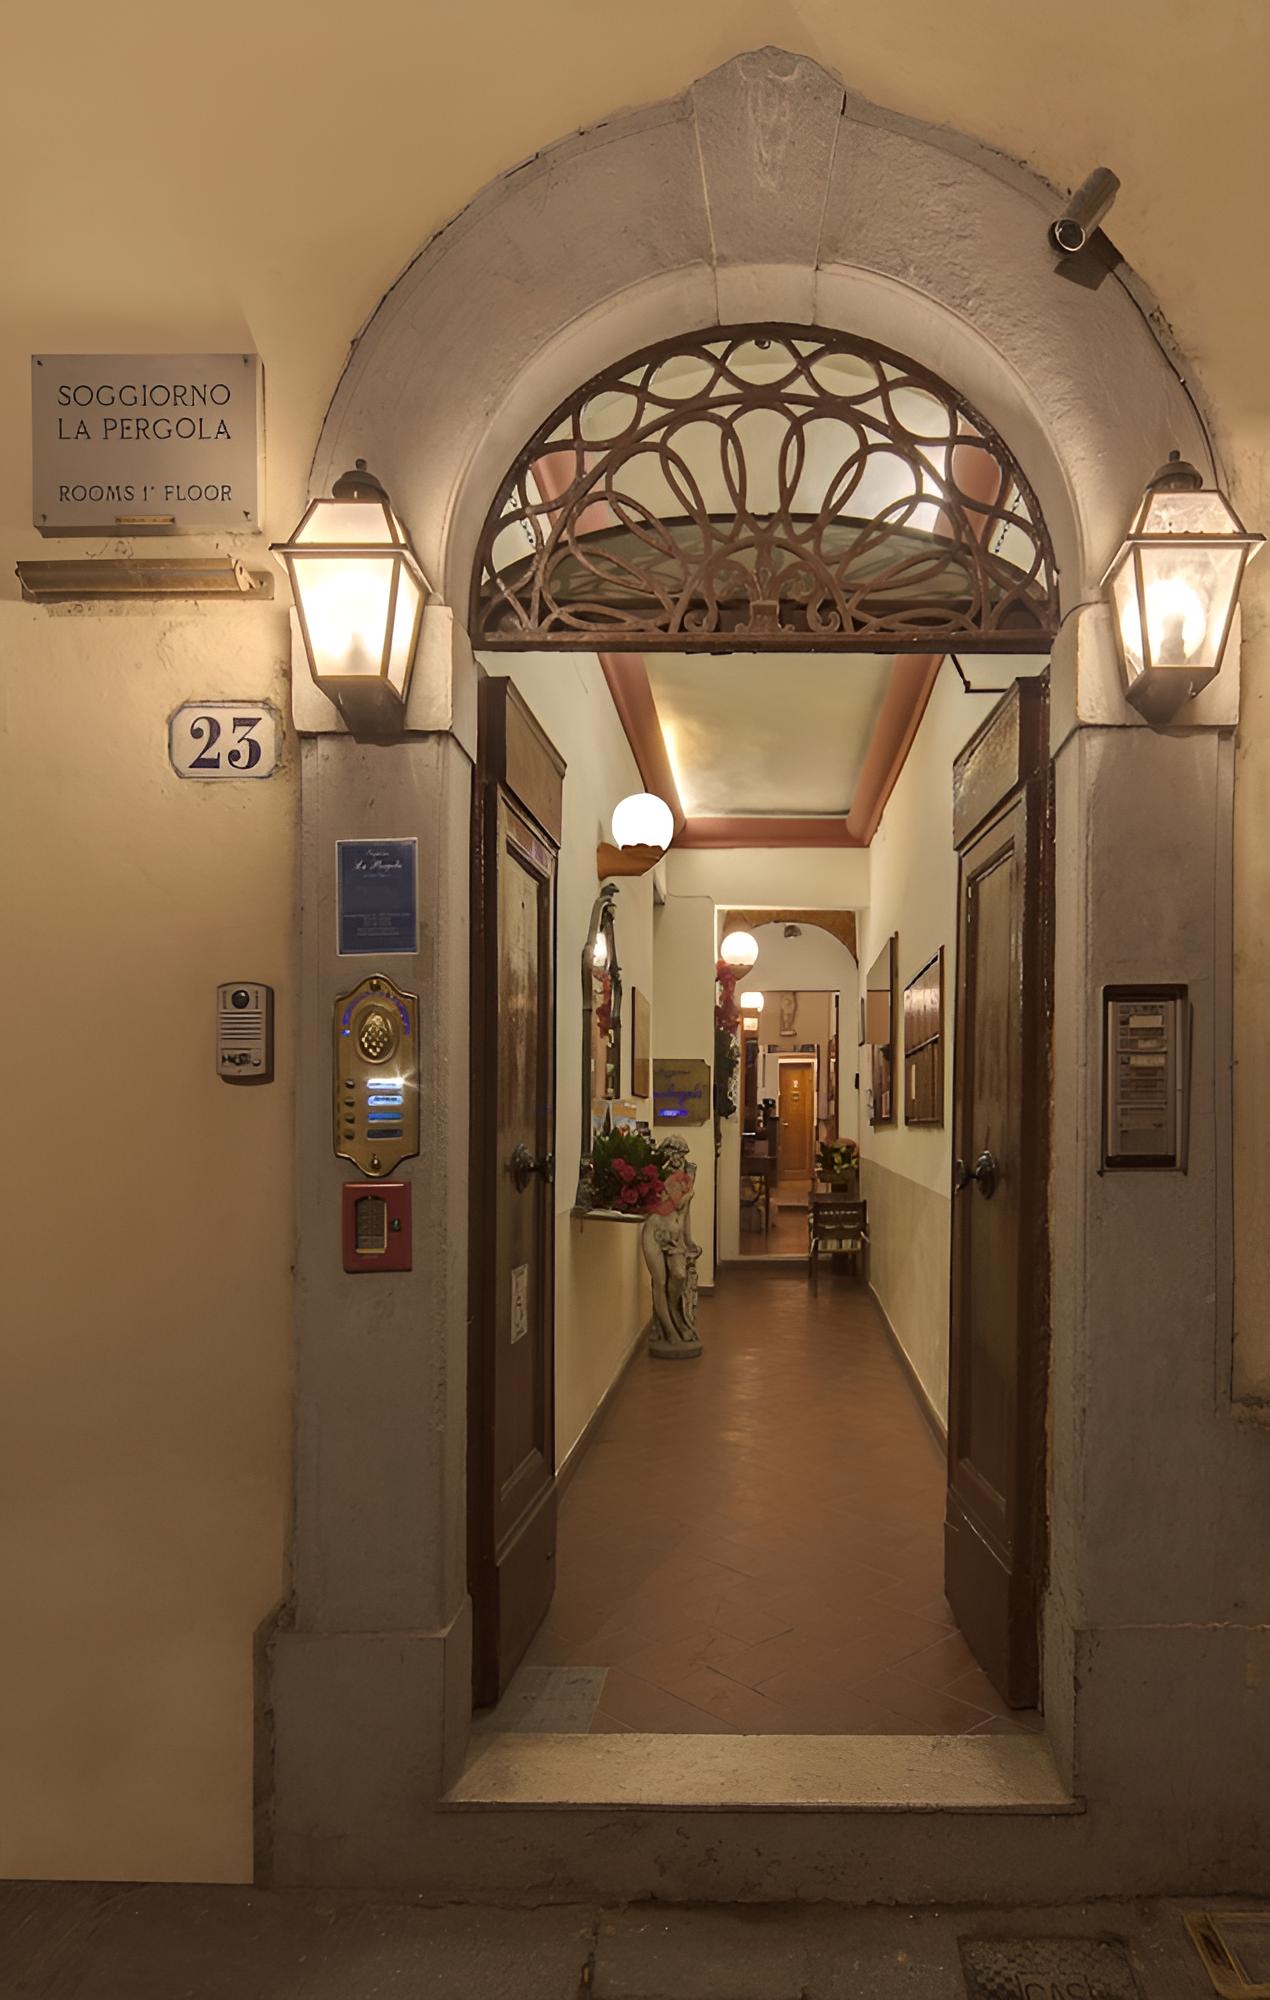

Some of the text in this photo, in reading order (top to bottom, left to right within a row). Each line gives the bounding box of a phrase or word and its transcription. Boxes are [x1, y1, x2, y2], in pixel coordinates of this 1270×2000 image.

[57, 383, 231, 407] SOGGIORNO
[58, 416, 232, 441] LA PERGOLA
[59, 484, 135, 503] ROOMS
[164, 484, 233, 502] FLOOR
[188, 716, 262, 770] 23
